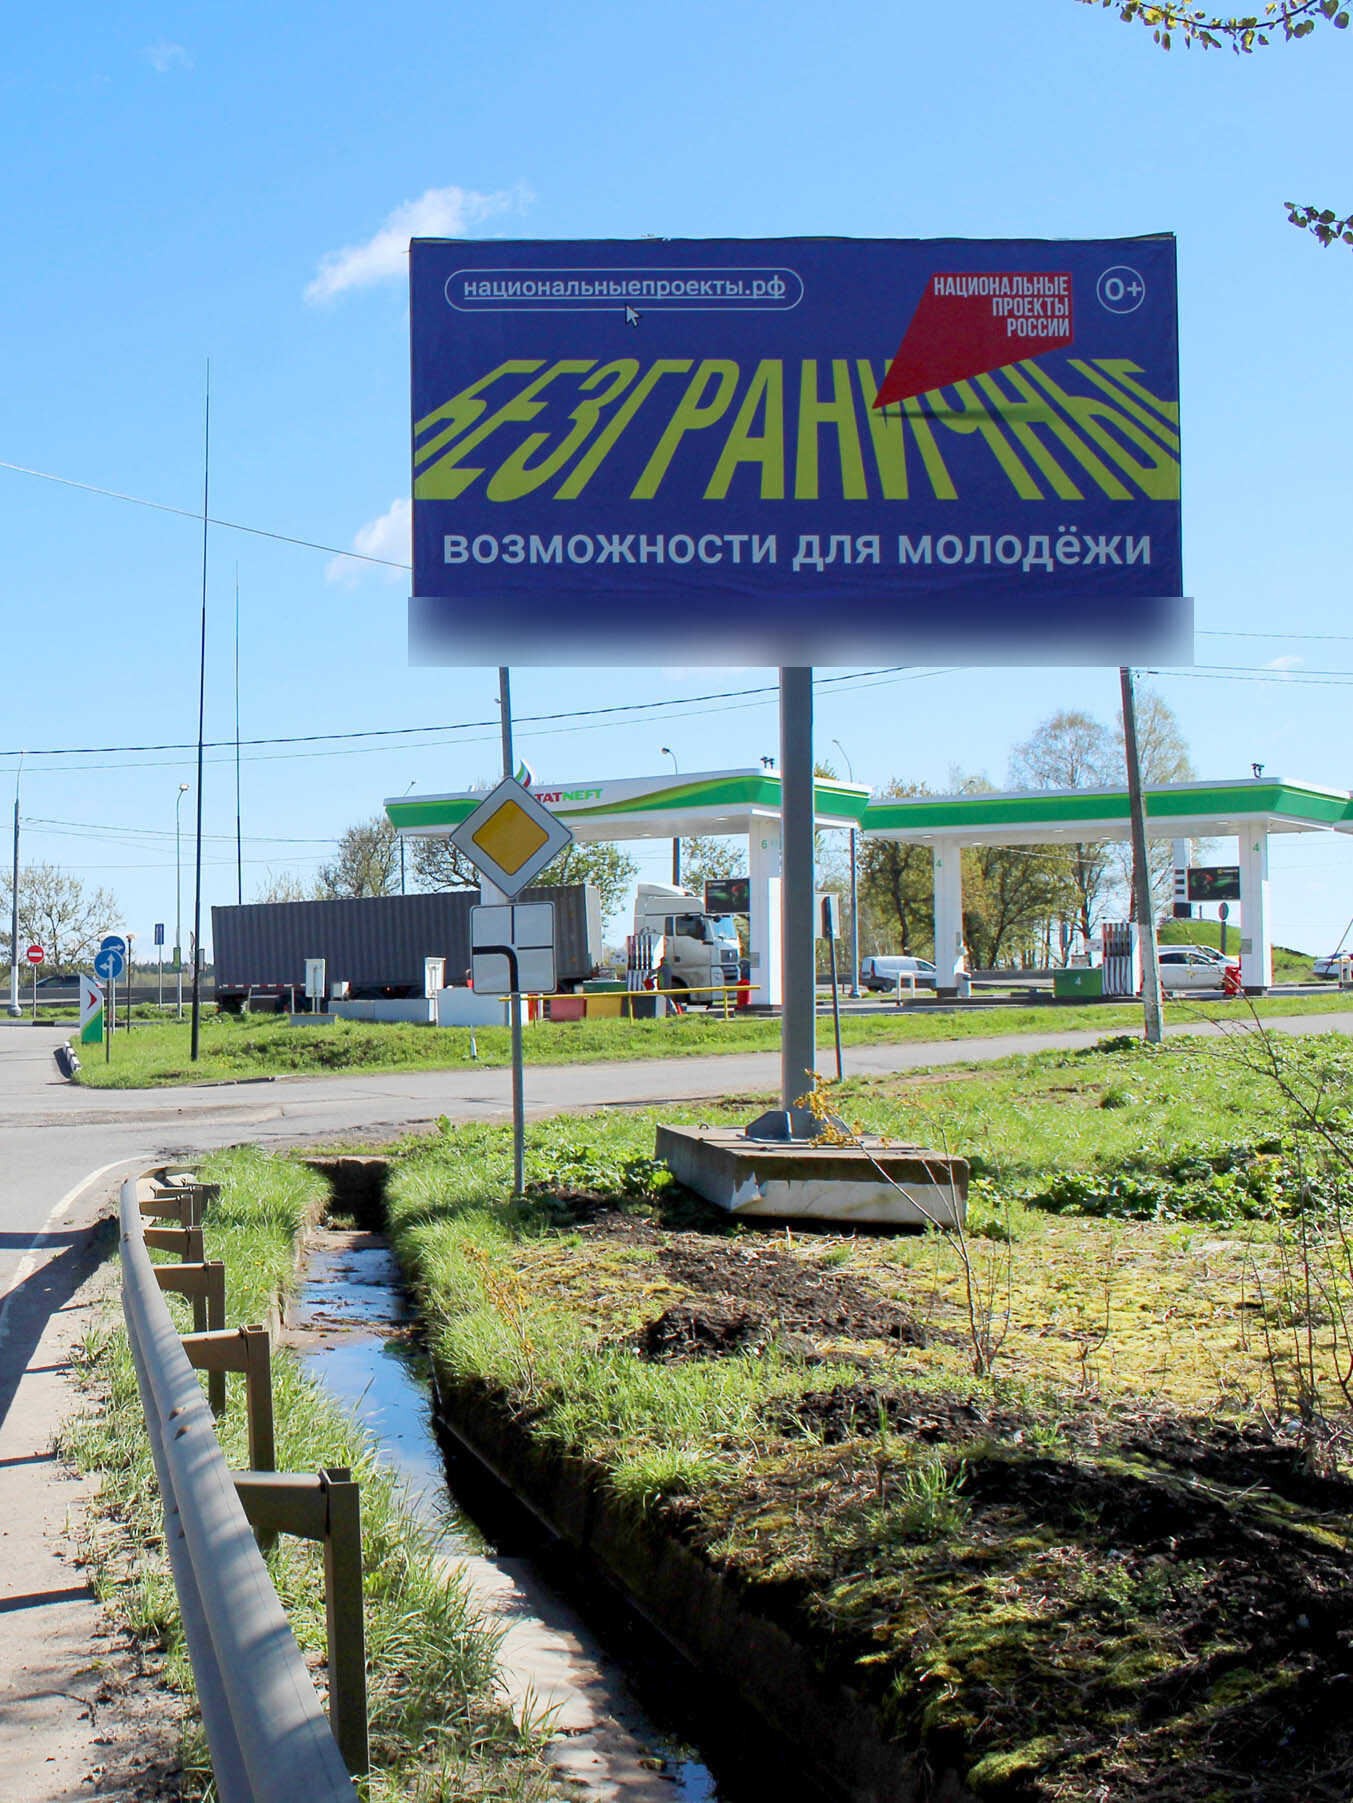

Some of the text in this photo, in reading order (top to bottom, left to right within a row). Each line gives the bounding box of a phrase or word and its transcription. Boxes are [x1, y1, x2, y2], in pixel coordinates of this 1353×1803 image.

[463, 275, 786, 300] национальныепроекты.рф
[933, 276, 1070, 298] НАЦИОНАЛЬНЫЕ
[1104, 277, 1143, 301] 0+
[991, 297, 1070, 317] ПРОЕКТЫ
[1006, 317, 1071, 337] РОССИИ
[443, 525, 1152, 573] возможности для молодёжи
[534, 788, 604, 802] TATNEFT
